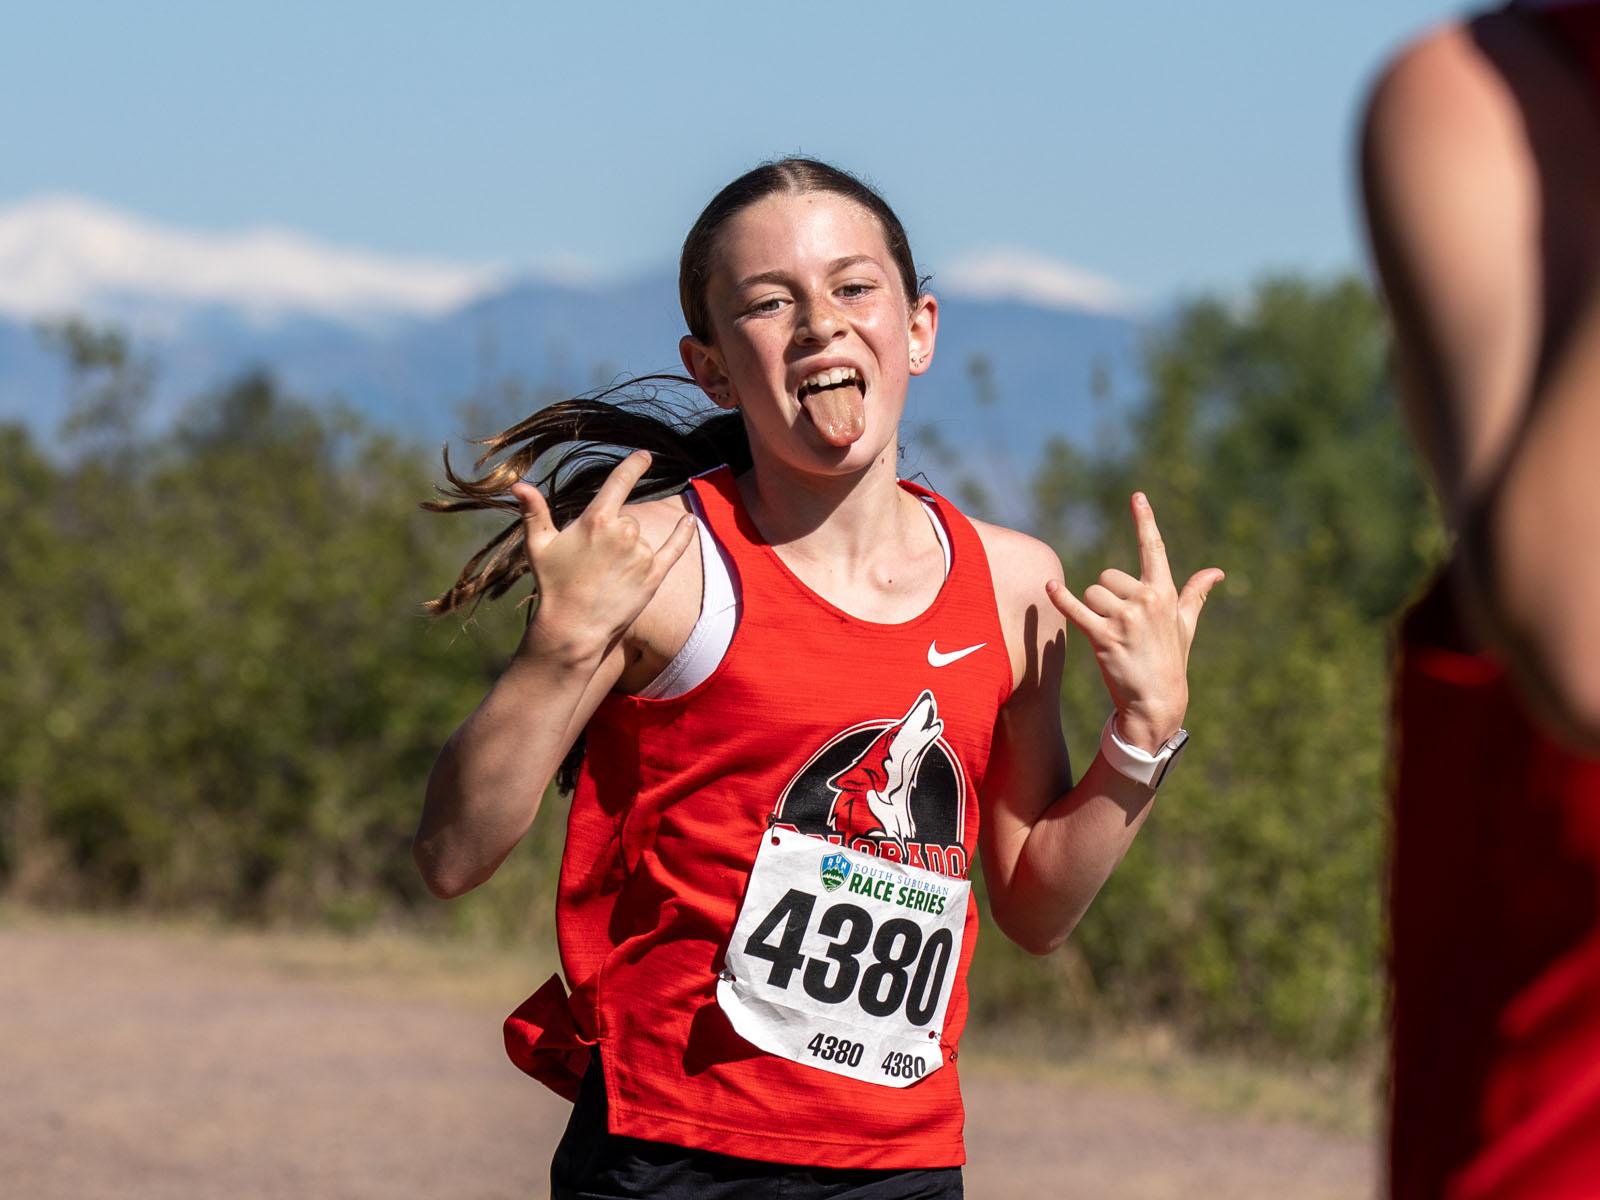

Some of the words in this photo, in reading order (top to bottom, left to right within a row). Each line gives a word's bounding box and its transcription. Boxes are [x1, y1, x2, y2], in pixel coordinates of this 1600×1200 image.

[827, 855, 848, 870] RUN
[853, 863, 893, 881] SOUTH
[897, 875, 949, 896] SUBURBAN
[848, 872, 895, 902] RACE
[895, 887, 947, 915] SERIES
[743, 888, 953, 1026] 4380
[807, 1032, 864, 1068] 4380
[881, 1051, 926, 1079] 4380
